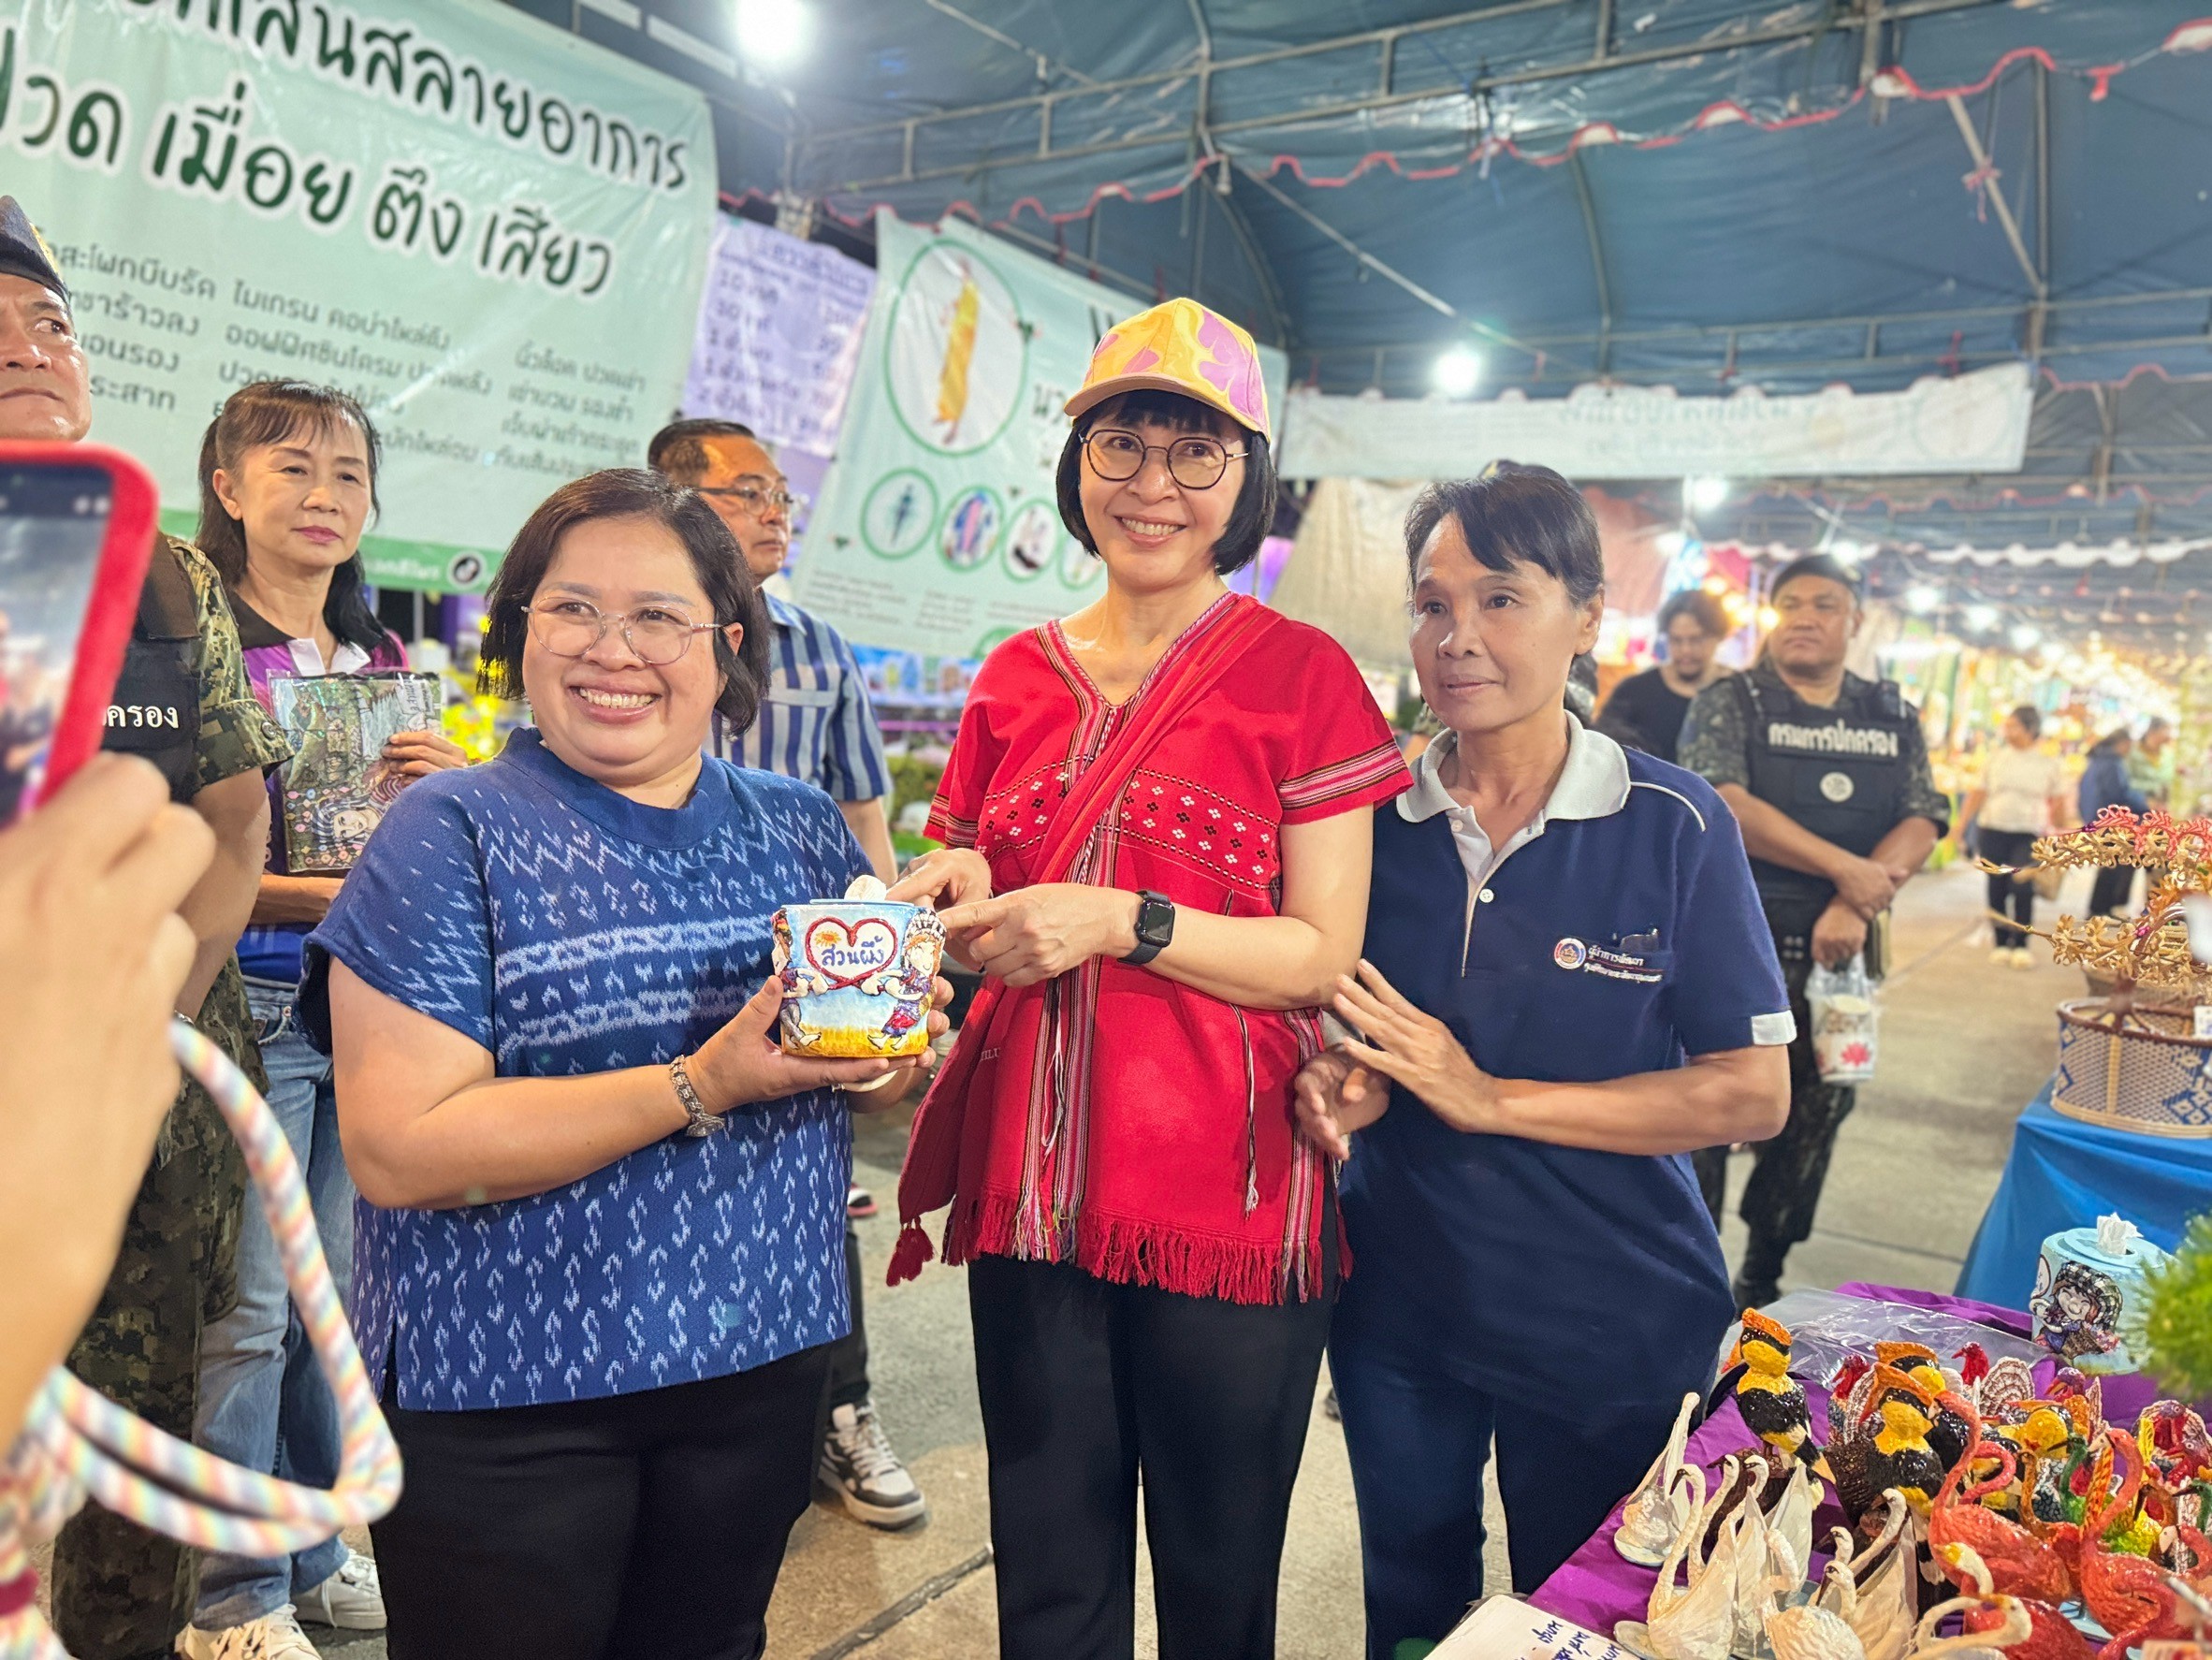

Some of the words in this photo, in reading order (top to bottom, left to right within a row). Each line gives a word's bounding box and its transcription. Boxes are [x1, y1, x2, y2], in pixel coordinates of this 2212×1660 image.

[153, 80, 353, 225] เมื่อย
[373, 167, 464, 255] ตึง
[480, 206, 611, 295] เสียว
[105, 705, 179, 729] ครอง
